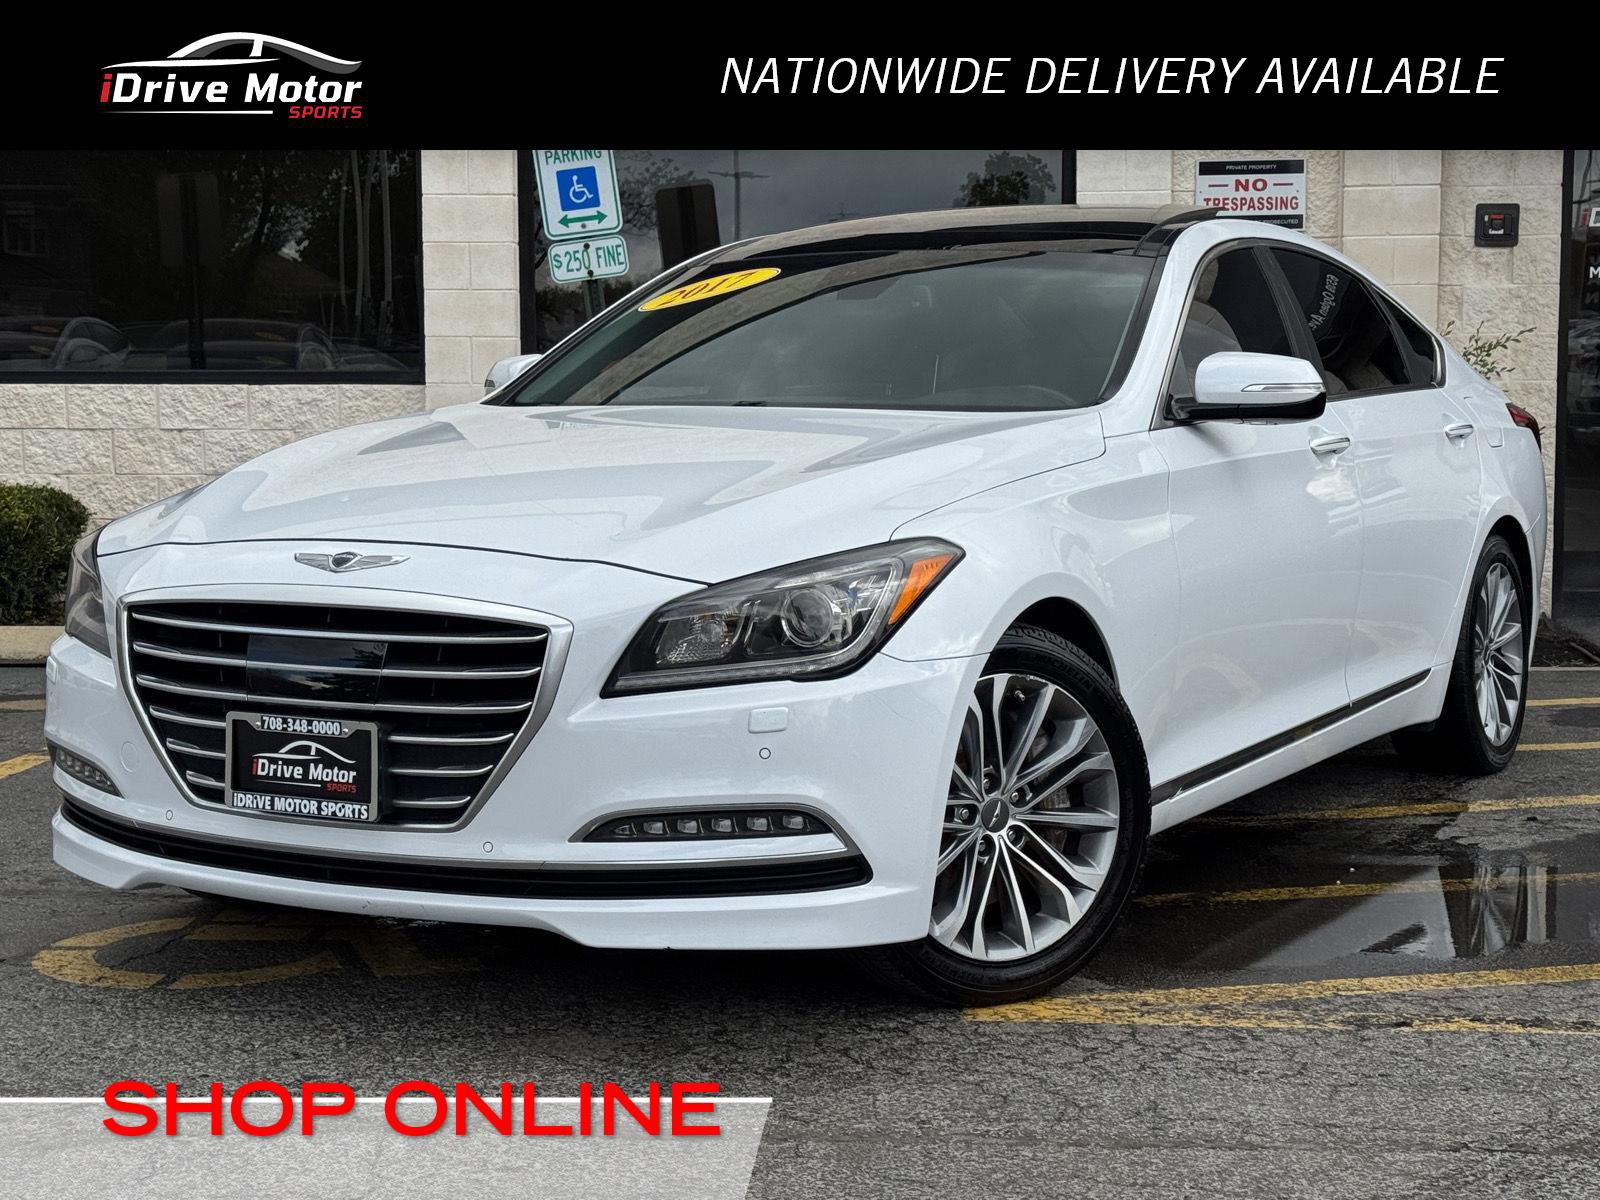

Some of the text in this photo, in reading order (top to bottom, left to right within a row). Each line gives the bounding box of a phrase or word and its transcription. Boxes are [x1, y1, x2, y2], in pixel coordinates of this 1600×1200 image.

[544, 150, 602, 165] PARKING
[1234, 179, 1268, 192] NO
[1203, 196, 1299, 212] TRESPASSING
[552, 244, 625, 273] $250 FINE
[656, 271, 758, 307] 2017
[262, 716, 341, 736] 708-348-0000
[251, 757, 357, 784] iDrive Motor
[326, 782, 358, 794] SPORTS
[274, 796, 319, 815] MOTOR
[320, 802, 369, 820] SPORTS
